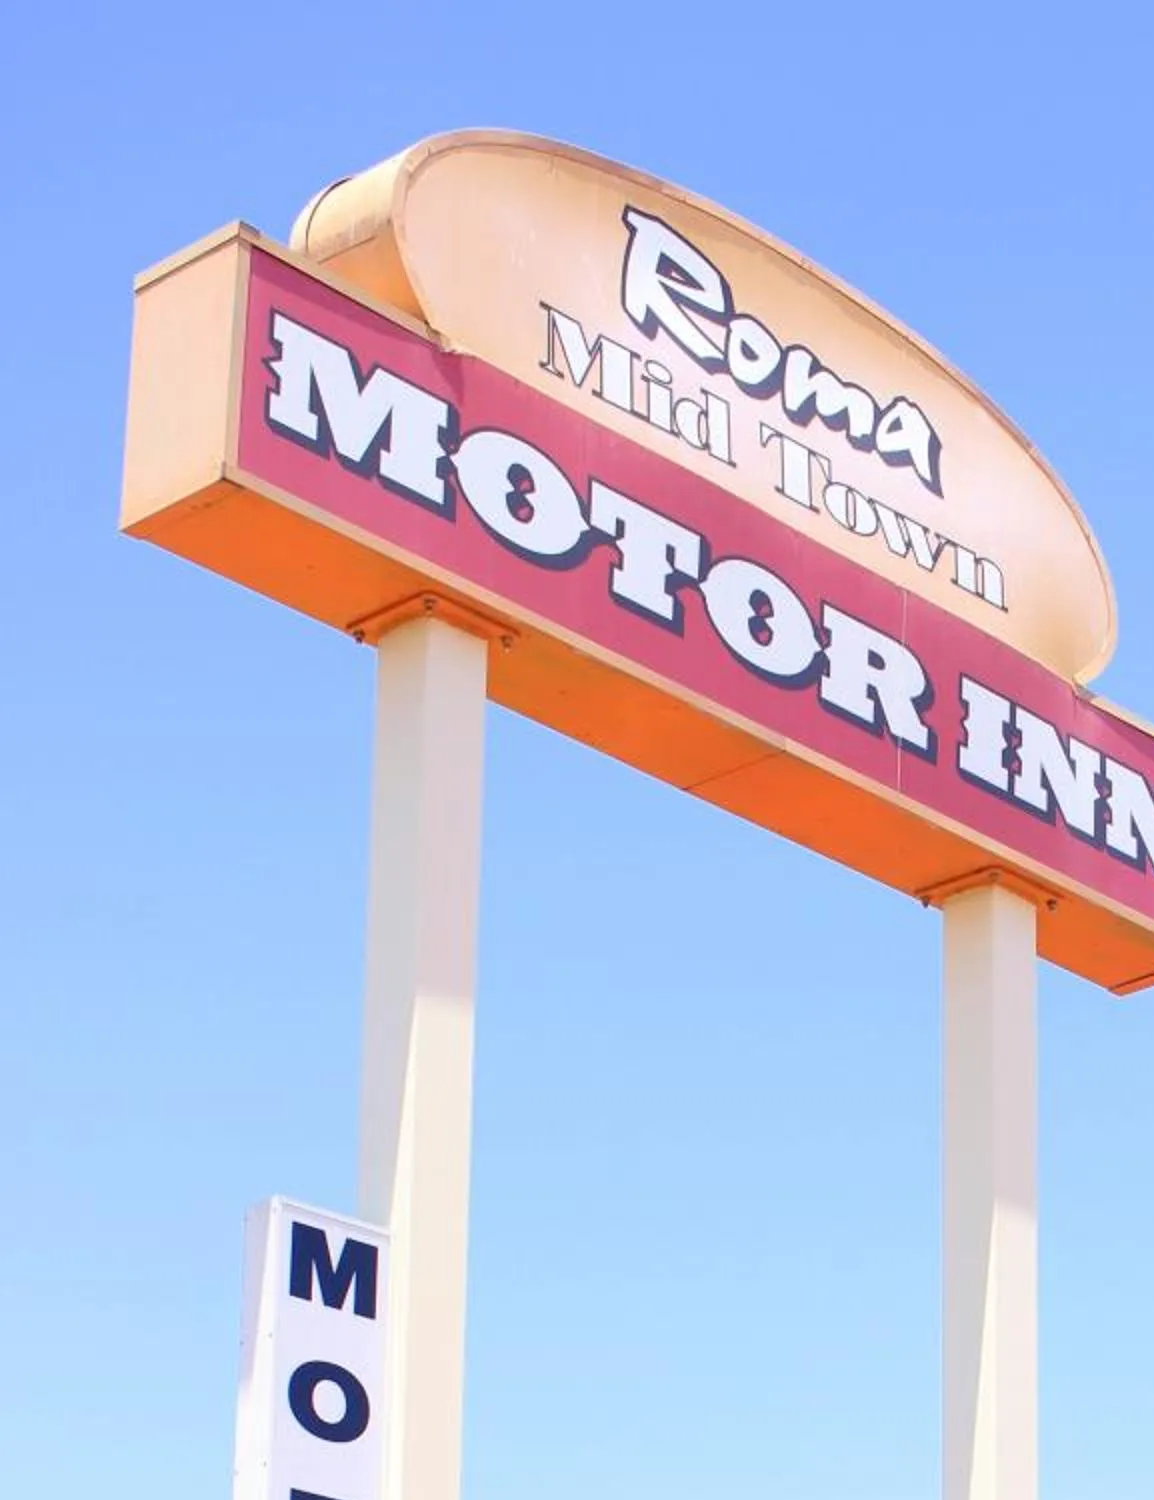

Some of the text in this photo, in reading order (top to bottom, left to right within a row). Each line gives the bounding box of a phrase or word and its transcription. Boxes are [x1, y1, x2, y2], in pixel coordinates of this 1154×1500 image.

[540, 302, 1008, 613] Mid Town
[621, 204, 943, 499] Roma
[264, 308, 938, 765] MOTOR
